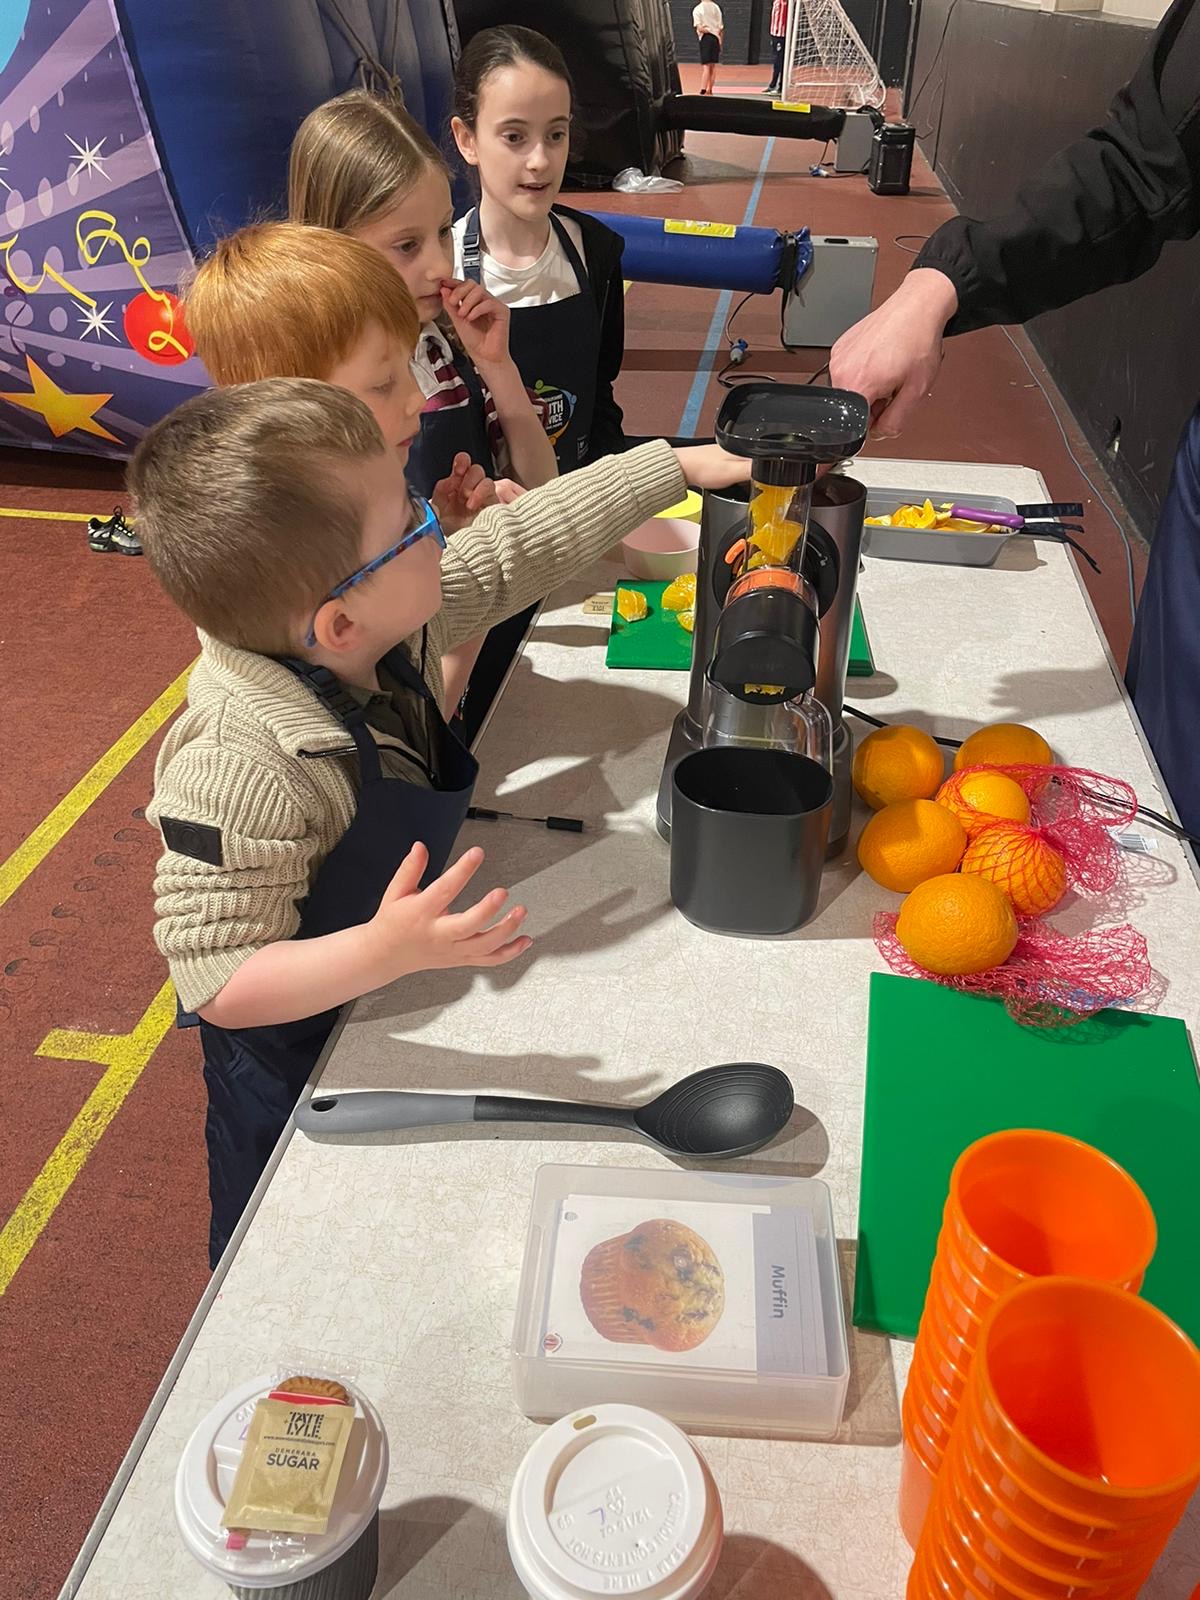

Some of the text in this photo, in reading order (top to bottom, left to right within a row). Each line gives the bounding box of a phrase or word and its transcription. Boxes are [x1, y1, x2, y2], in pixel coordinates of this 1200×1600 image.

[771, 1264, 788, 1319] Muffin
[289, 1411, 324, 1425] TATE
[286, 1422, 322, 1440] LYLE
[266, 1453, 320, 1470] SUGAR
[275, 1447, 317, 1457] DEMERARA
[654, 1492, 682, 1543] CAUTION
[566, 1536, 591, 1560] HOT
[592, 1540, 657, 1568] CONTENTS
